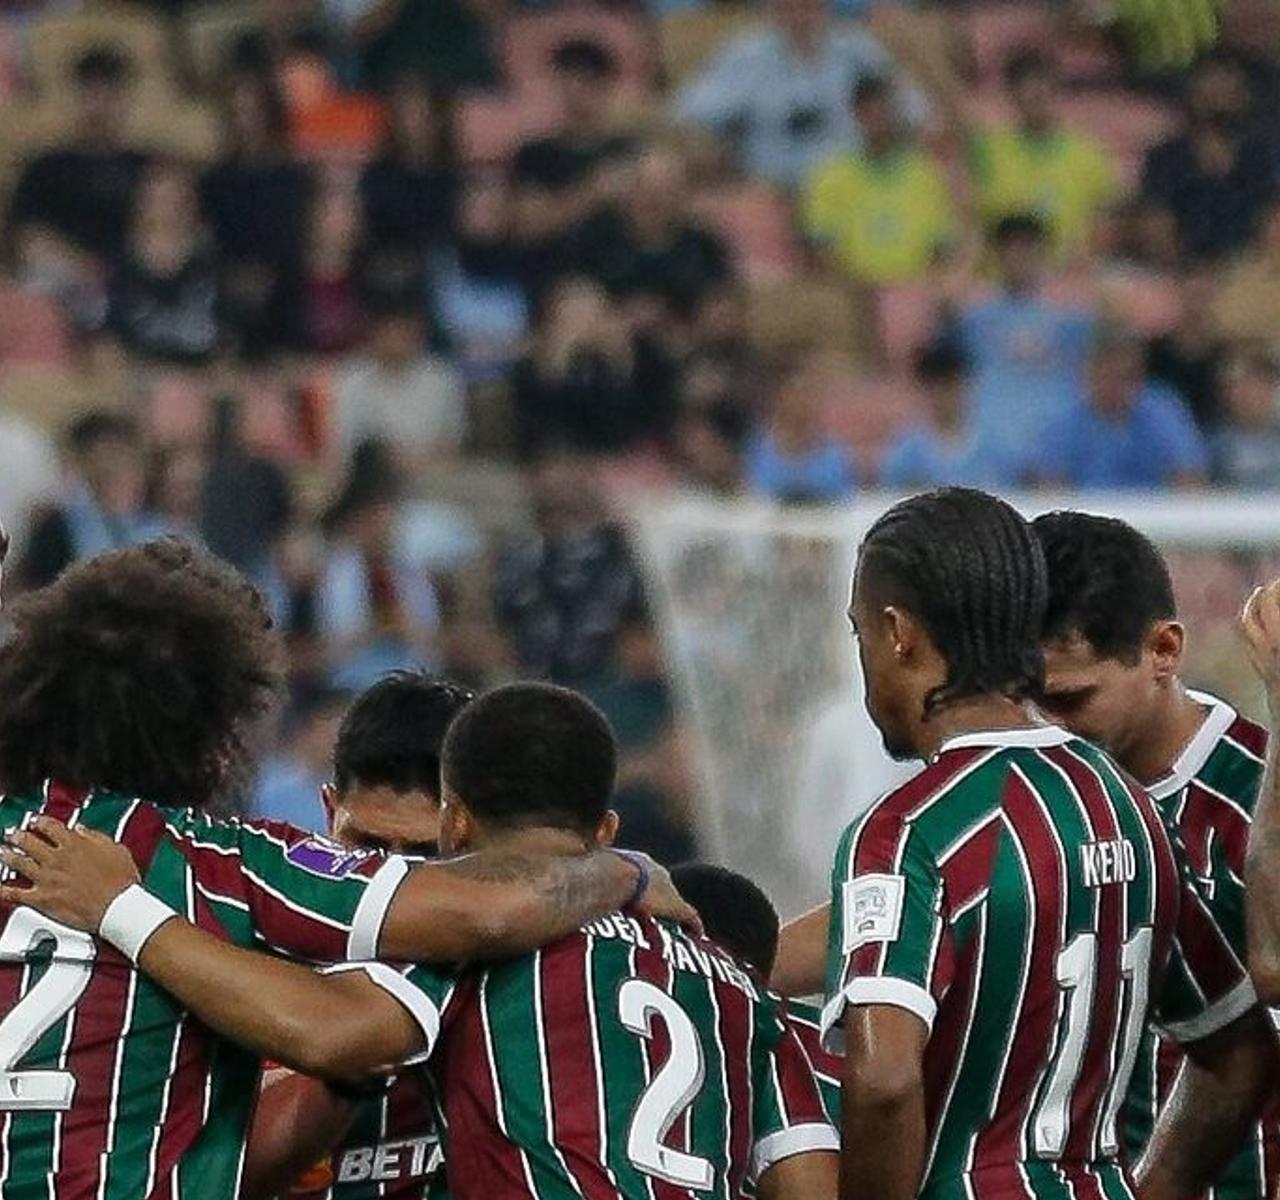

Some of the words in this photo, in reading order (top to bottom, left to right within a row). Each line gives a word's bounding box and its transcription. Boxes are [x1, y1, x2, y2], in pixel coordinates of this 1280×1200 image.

[1079, 838, 1136, 888] KENO
[580, 910, 650, 951] UEL
[618, 978, 714, 1192] 2
[1034, 926, 1153, 1158] 11
